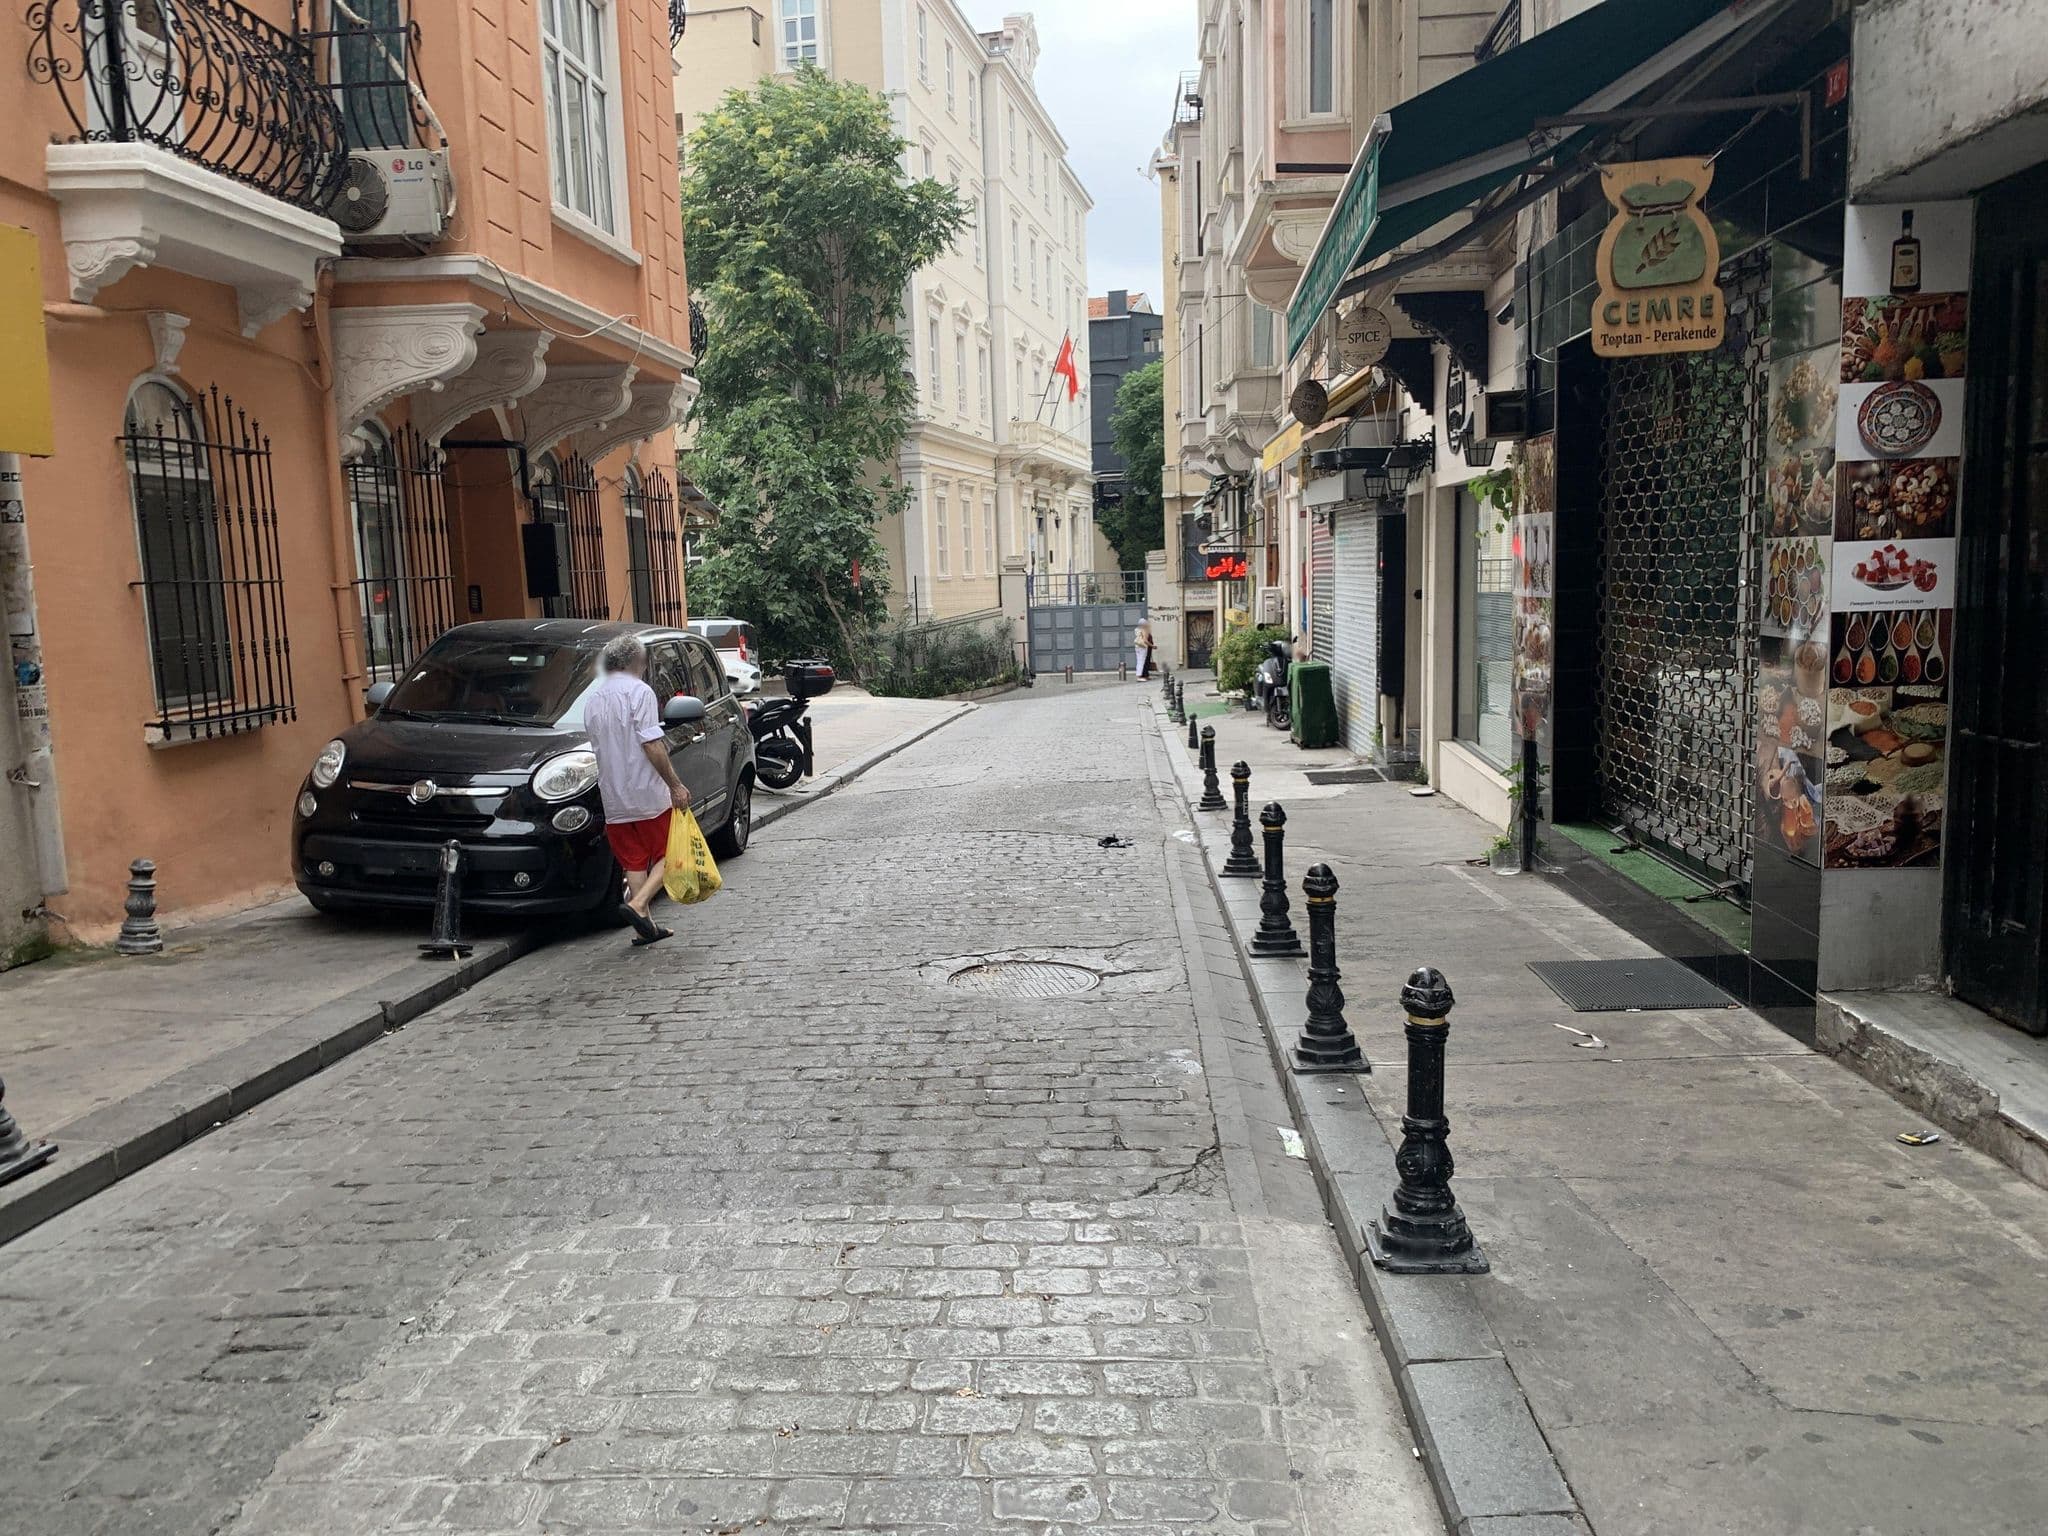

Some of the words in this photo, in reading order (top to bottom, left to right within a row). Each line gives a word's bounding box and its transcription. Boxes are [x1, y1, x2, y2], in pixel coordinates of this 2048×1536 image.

[408, 161, 424, 171] LG
[1602, 293, 1714, 326] CEMRE
[1347, 330, 1381, 344] SPICE
[1601, 332, 1642, 348] Toptan
[1653, 324, 1717, 342] Perakende
